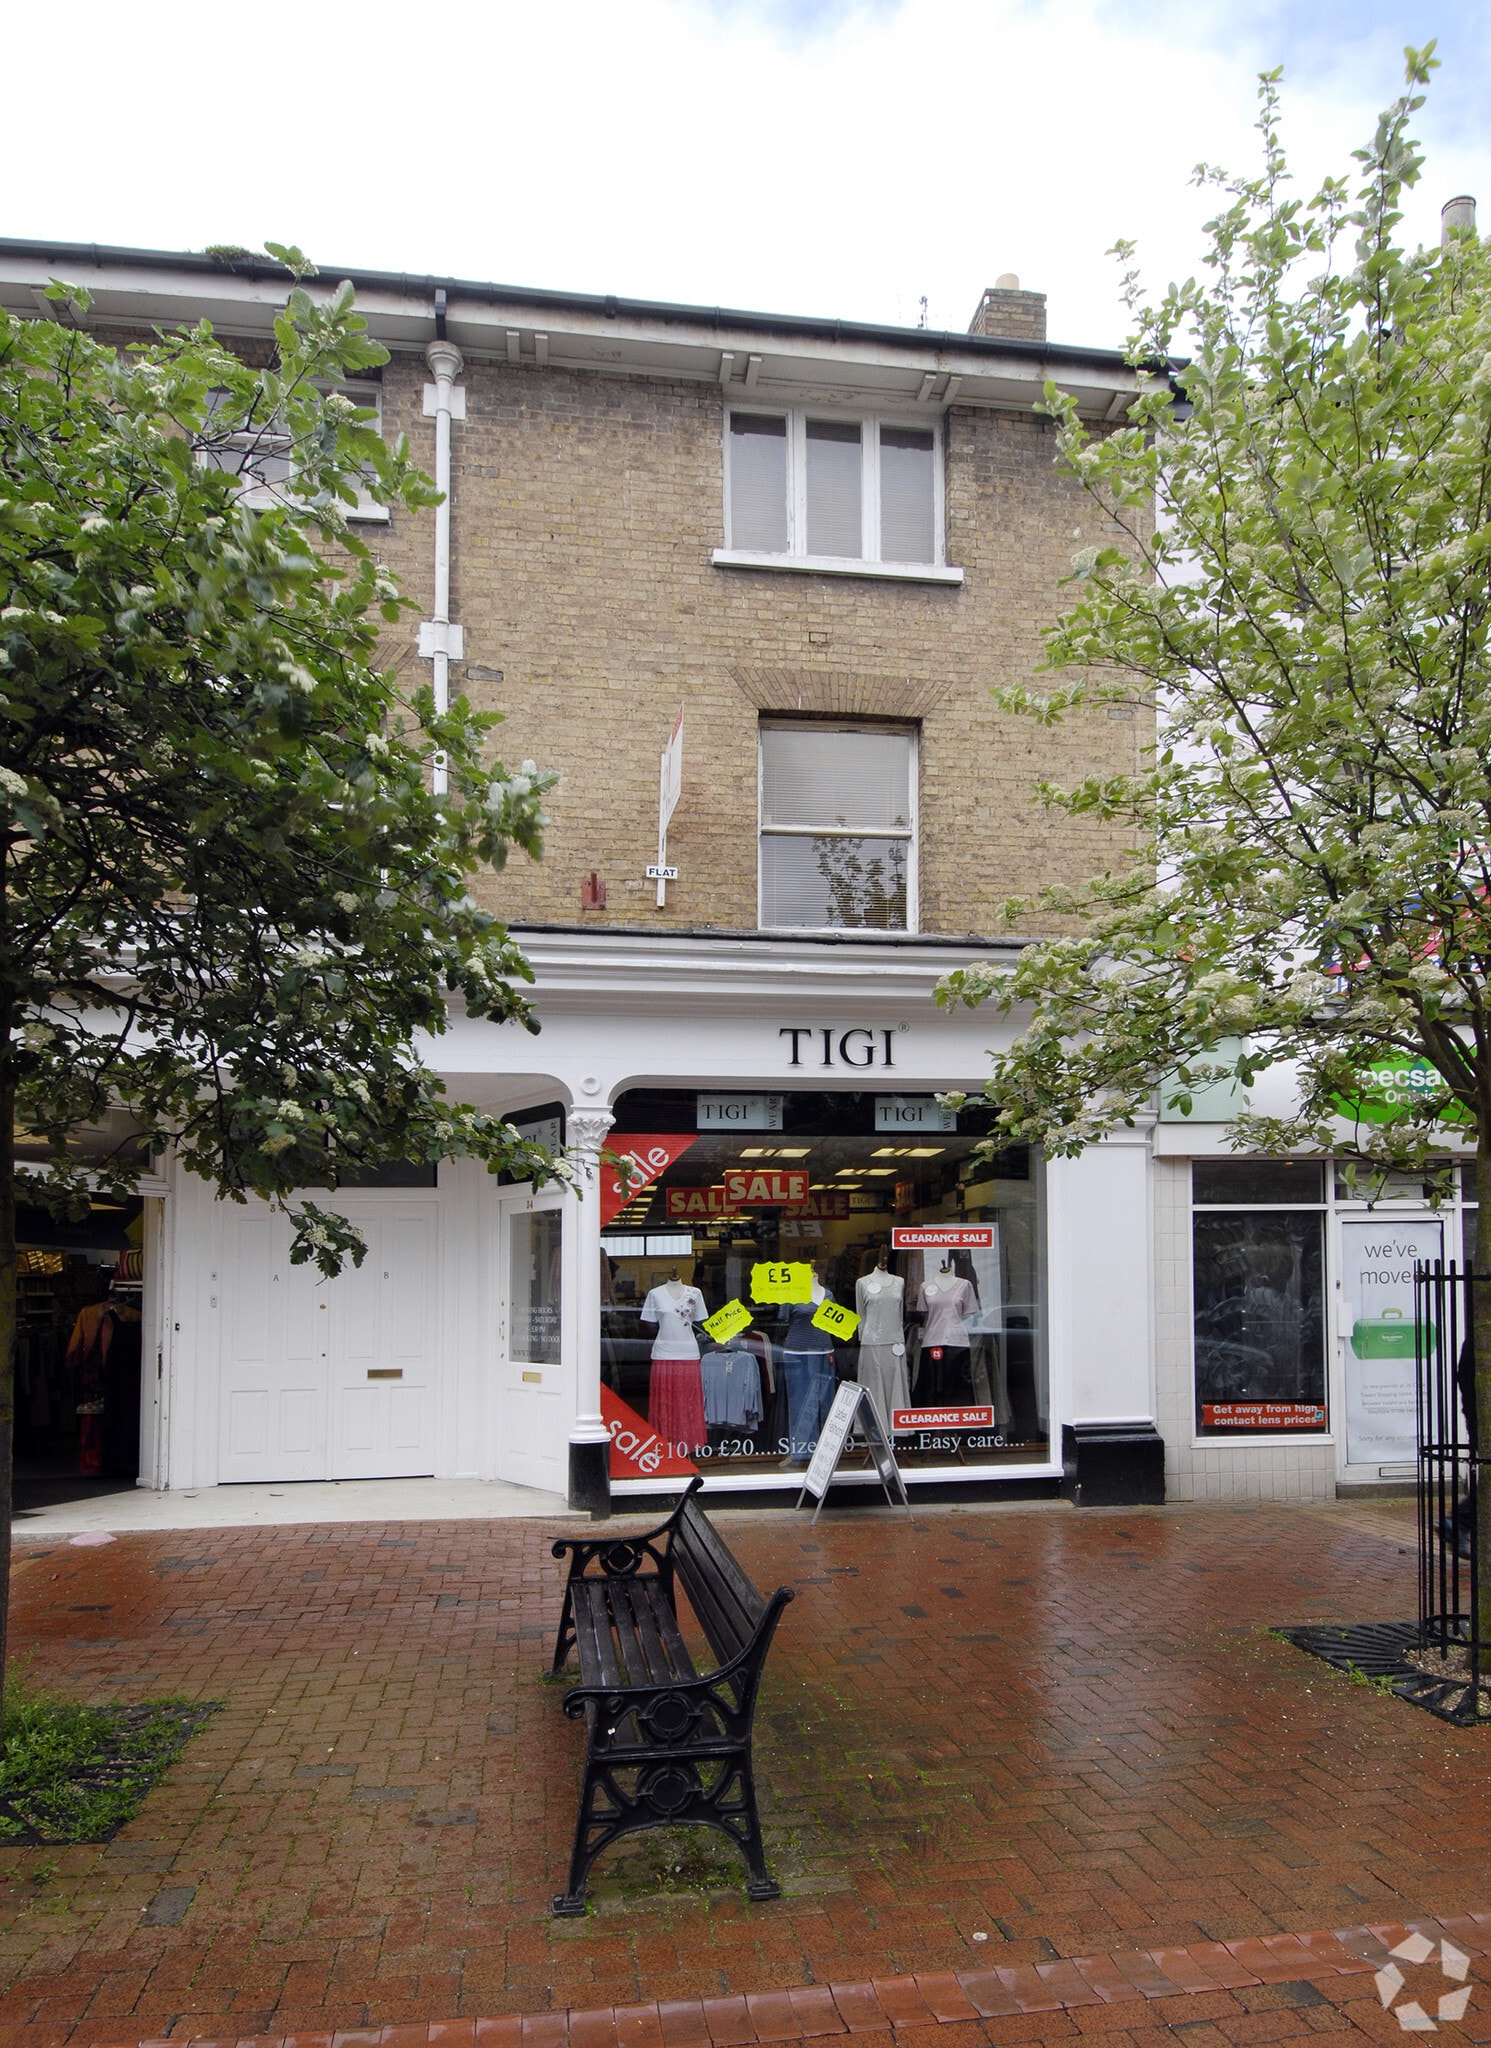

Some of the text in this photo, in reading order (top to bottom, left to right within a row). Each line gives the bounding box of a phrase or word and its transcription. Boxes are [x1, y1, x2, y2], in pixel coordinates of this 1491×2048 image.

[648, 868, 676, 877] FLAT
[779, 1028, 897, 1067] TIGI
[1348, 1068, 1449, 1090] pecsa
[702, 1104, 747, 1120] TIGI
[768, 1098, 777, 1128] WEAR
[880, 1106, 923, 1122] TIGI
[729, 1176, 805, 1200] SALE
[899, 1233, 988, 1243] CLEARANCE SALE
[1364, 1240, 1418, 1258] we've
[273, 1274, 280, 1282] A
[383, 1272, 389, 1280] B
[768, 1268, 791, 1283] £5
[709, 1316, 723, 1329] Half
[724, 1308, 742, 1319] Price
[823, 1306, 844, 1324] £10
[1213, 1405, 1317, 1414] Get away from high
[899, 1412, 988, 1424] CLEARANCE SALE
[1214, 1415, 1317, 1426] contact lens prices
[608, 1420, 660, 1473] sale
[653, 1441, 688, 1459] £10
[695, 1443, 712, 1458] to
